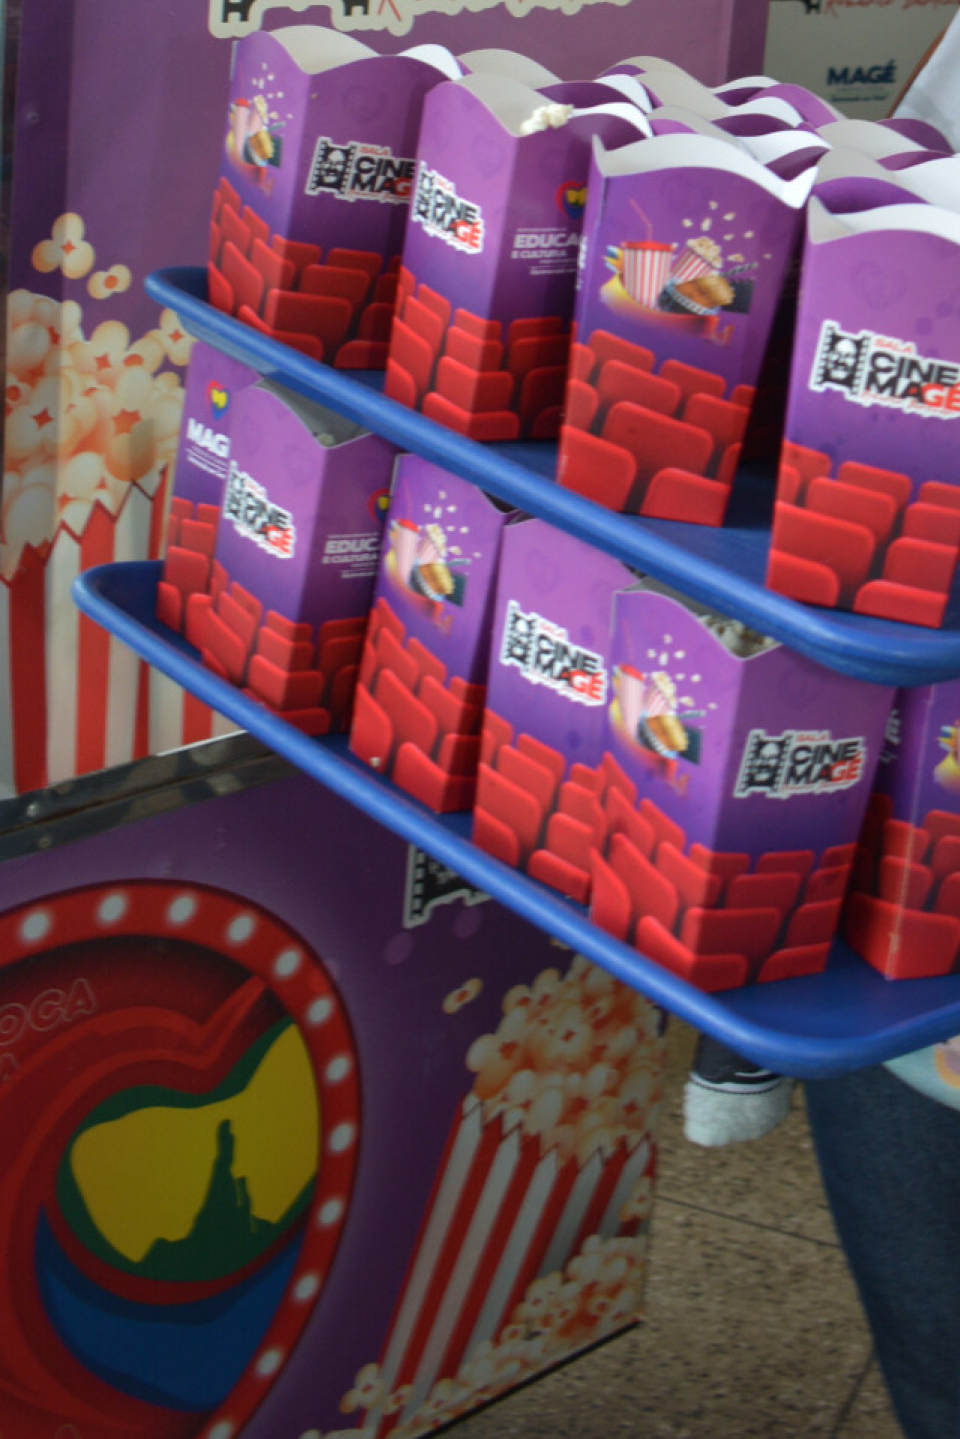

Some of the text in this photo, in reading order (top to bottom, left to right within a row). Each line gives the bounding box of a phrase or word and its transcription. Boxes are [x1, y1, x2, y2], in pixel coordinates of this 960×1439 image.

[826, 60, 897, 87] MAGÉ
[349, 173, 413, 197] MAG
[870, 351, 960, 387] CINE
[186, 418, 231, 459] MAG
[785, 751, 863, 784] MAGÉ
[791, 741, 860, 765] CINE
